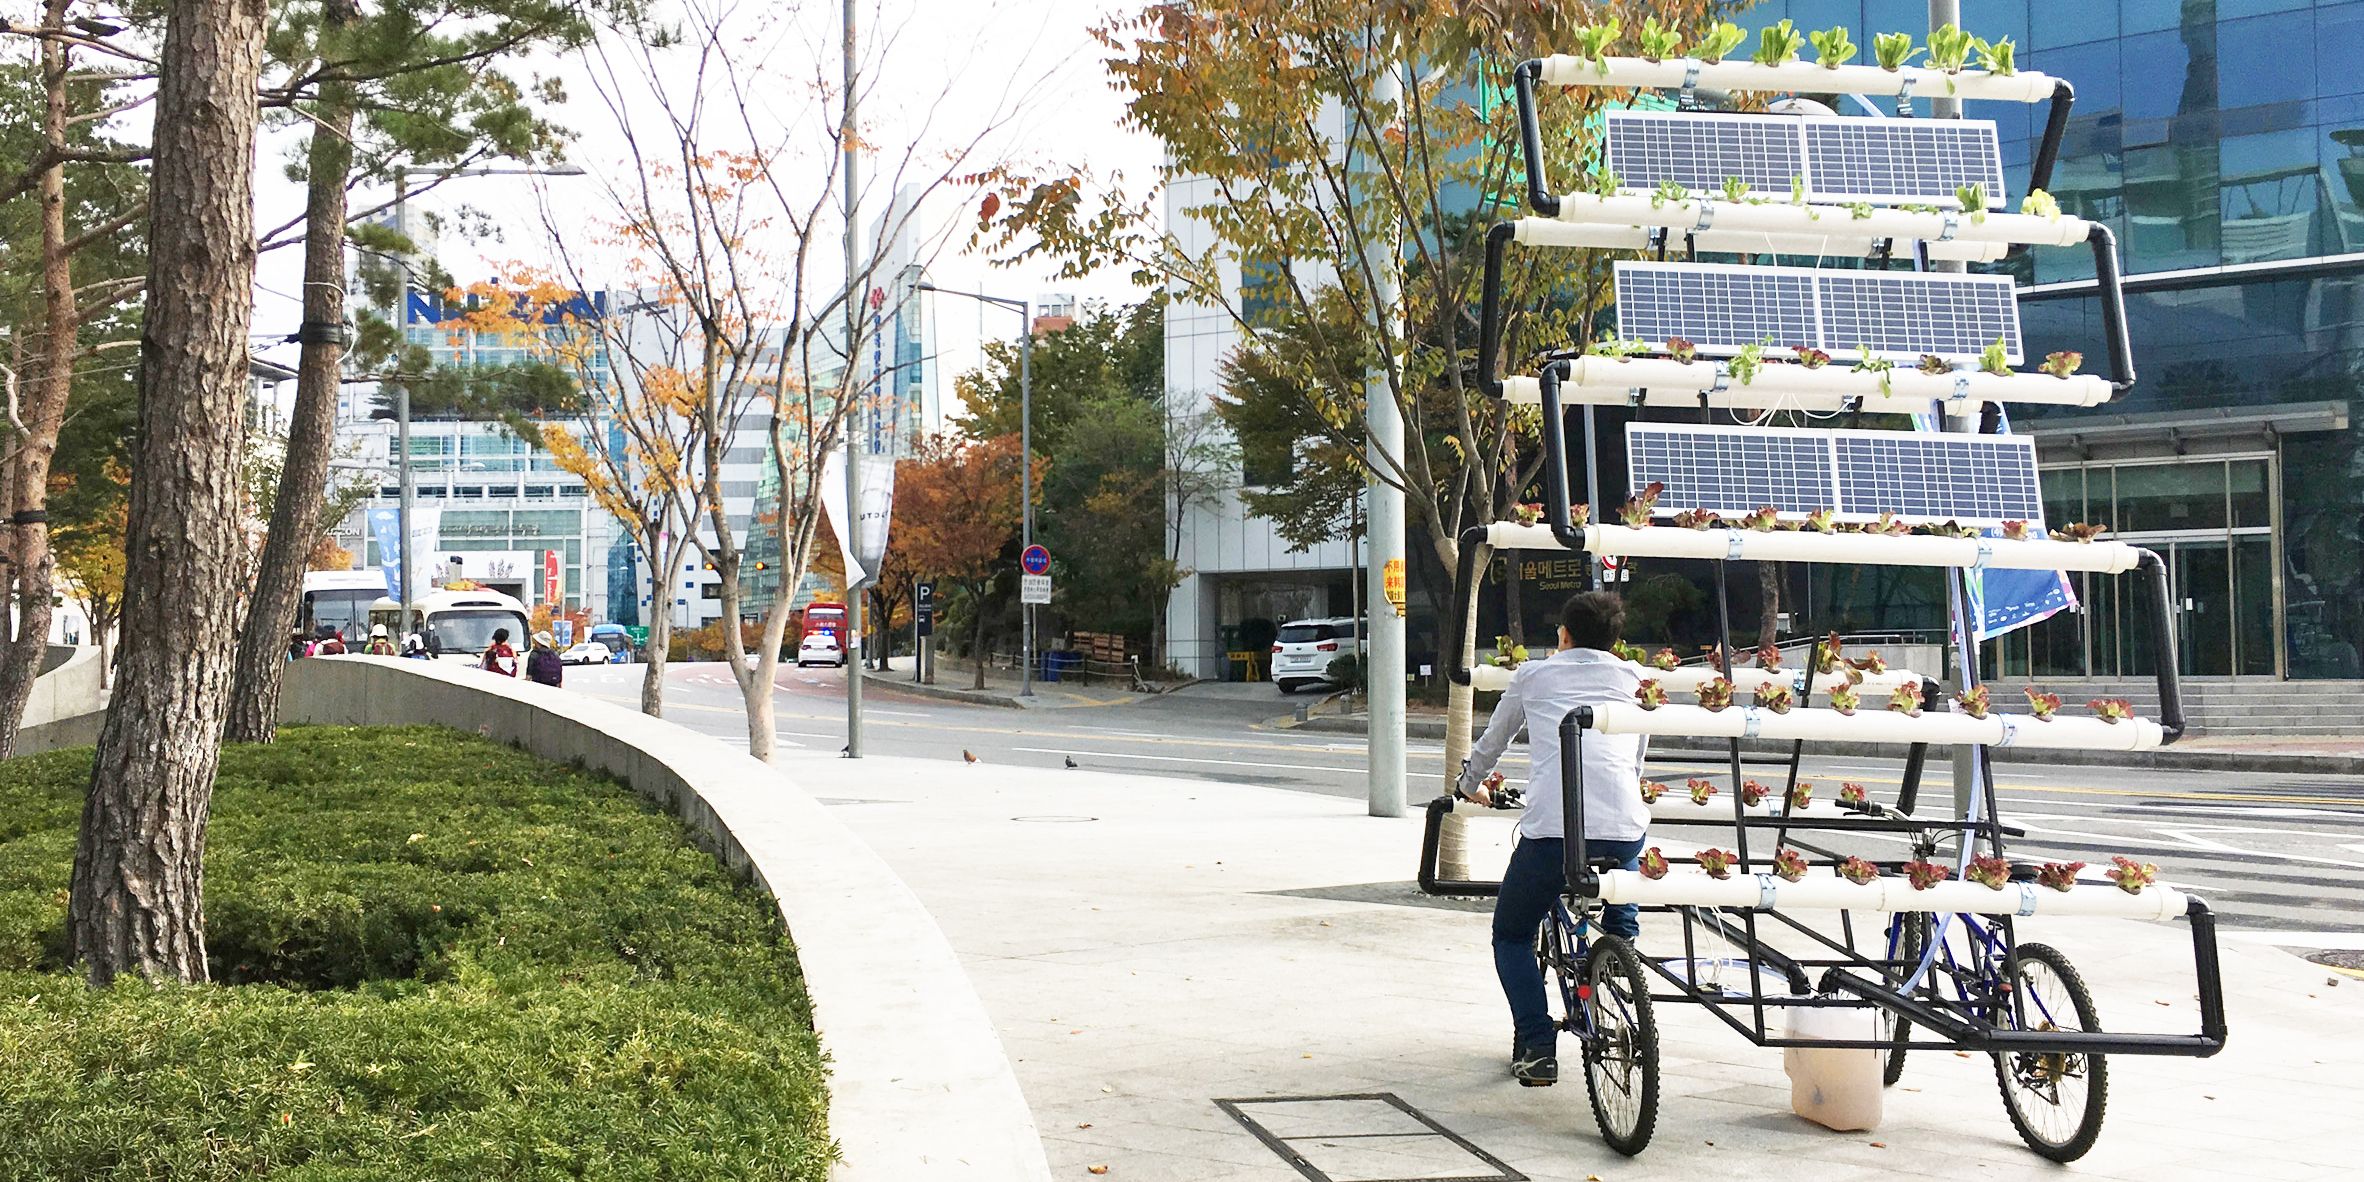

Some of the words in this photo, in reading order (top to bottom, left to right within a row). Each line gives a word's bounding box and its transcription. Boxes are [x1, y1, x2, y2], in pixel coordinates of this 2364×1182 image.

[1539, 581, 1559, 591] Seoul
[1561, 580, 1582, 589] Metro
[920, 586, 930, 601] P
